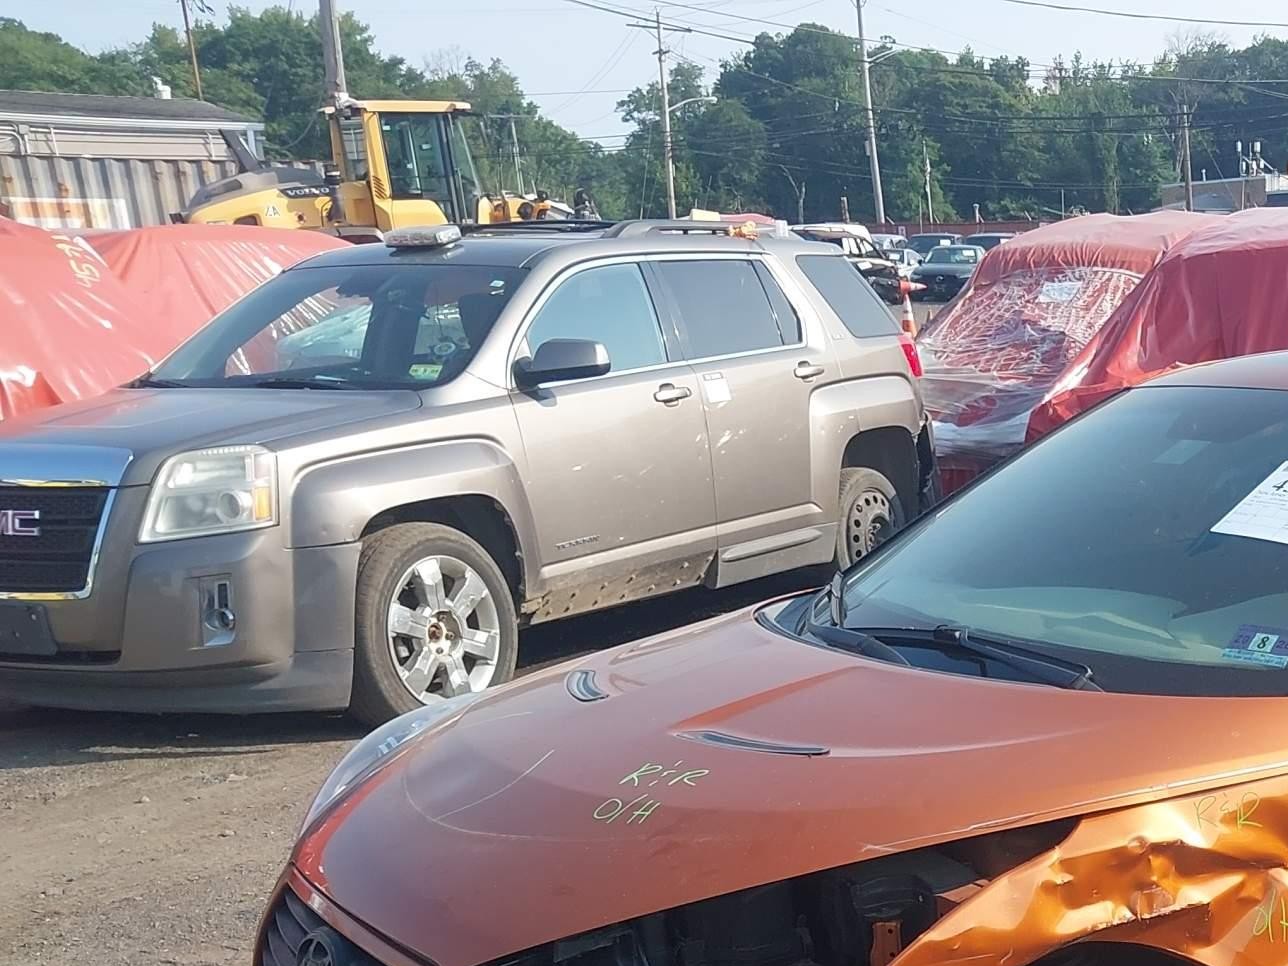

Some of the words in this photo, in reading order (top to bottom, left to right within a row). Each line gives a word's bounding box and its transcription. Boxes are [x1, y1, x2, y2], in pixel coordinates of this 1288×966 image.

[287, 187, 330, 196] VOLVO
[1257, 636, 1270, 649] 8
[593, 793, 662, 824] O/H
